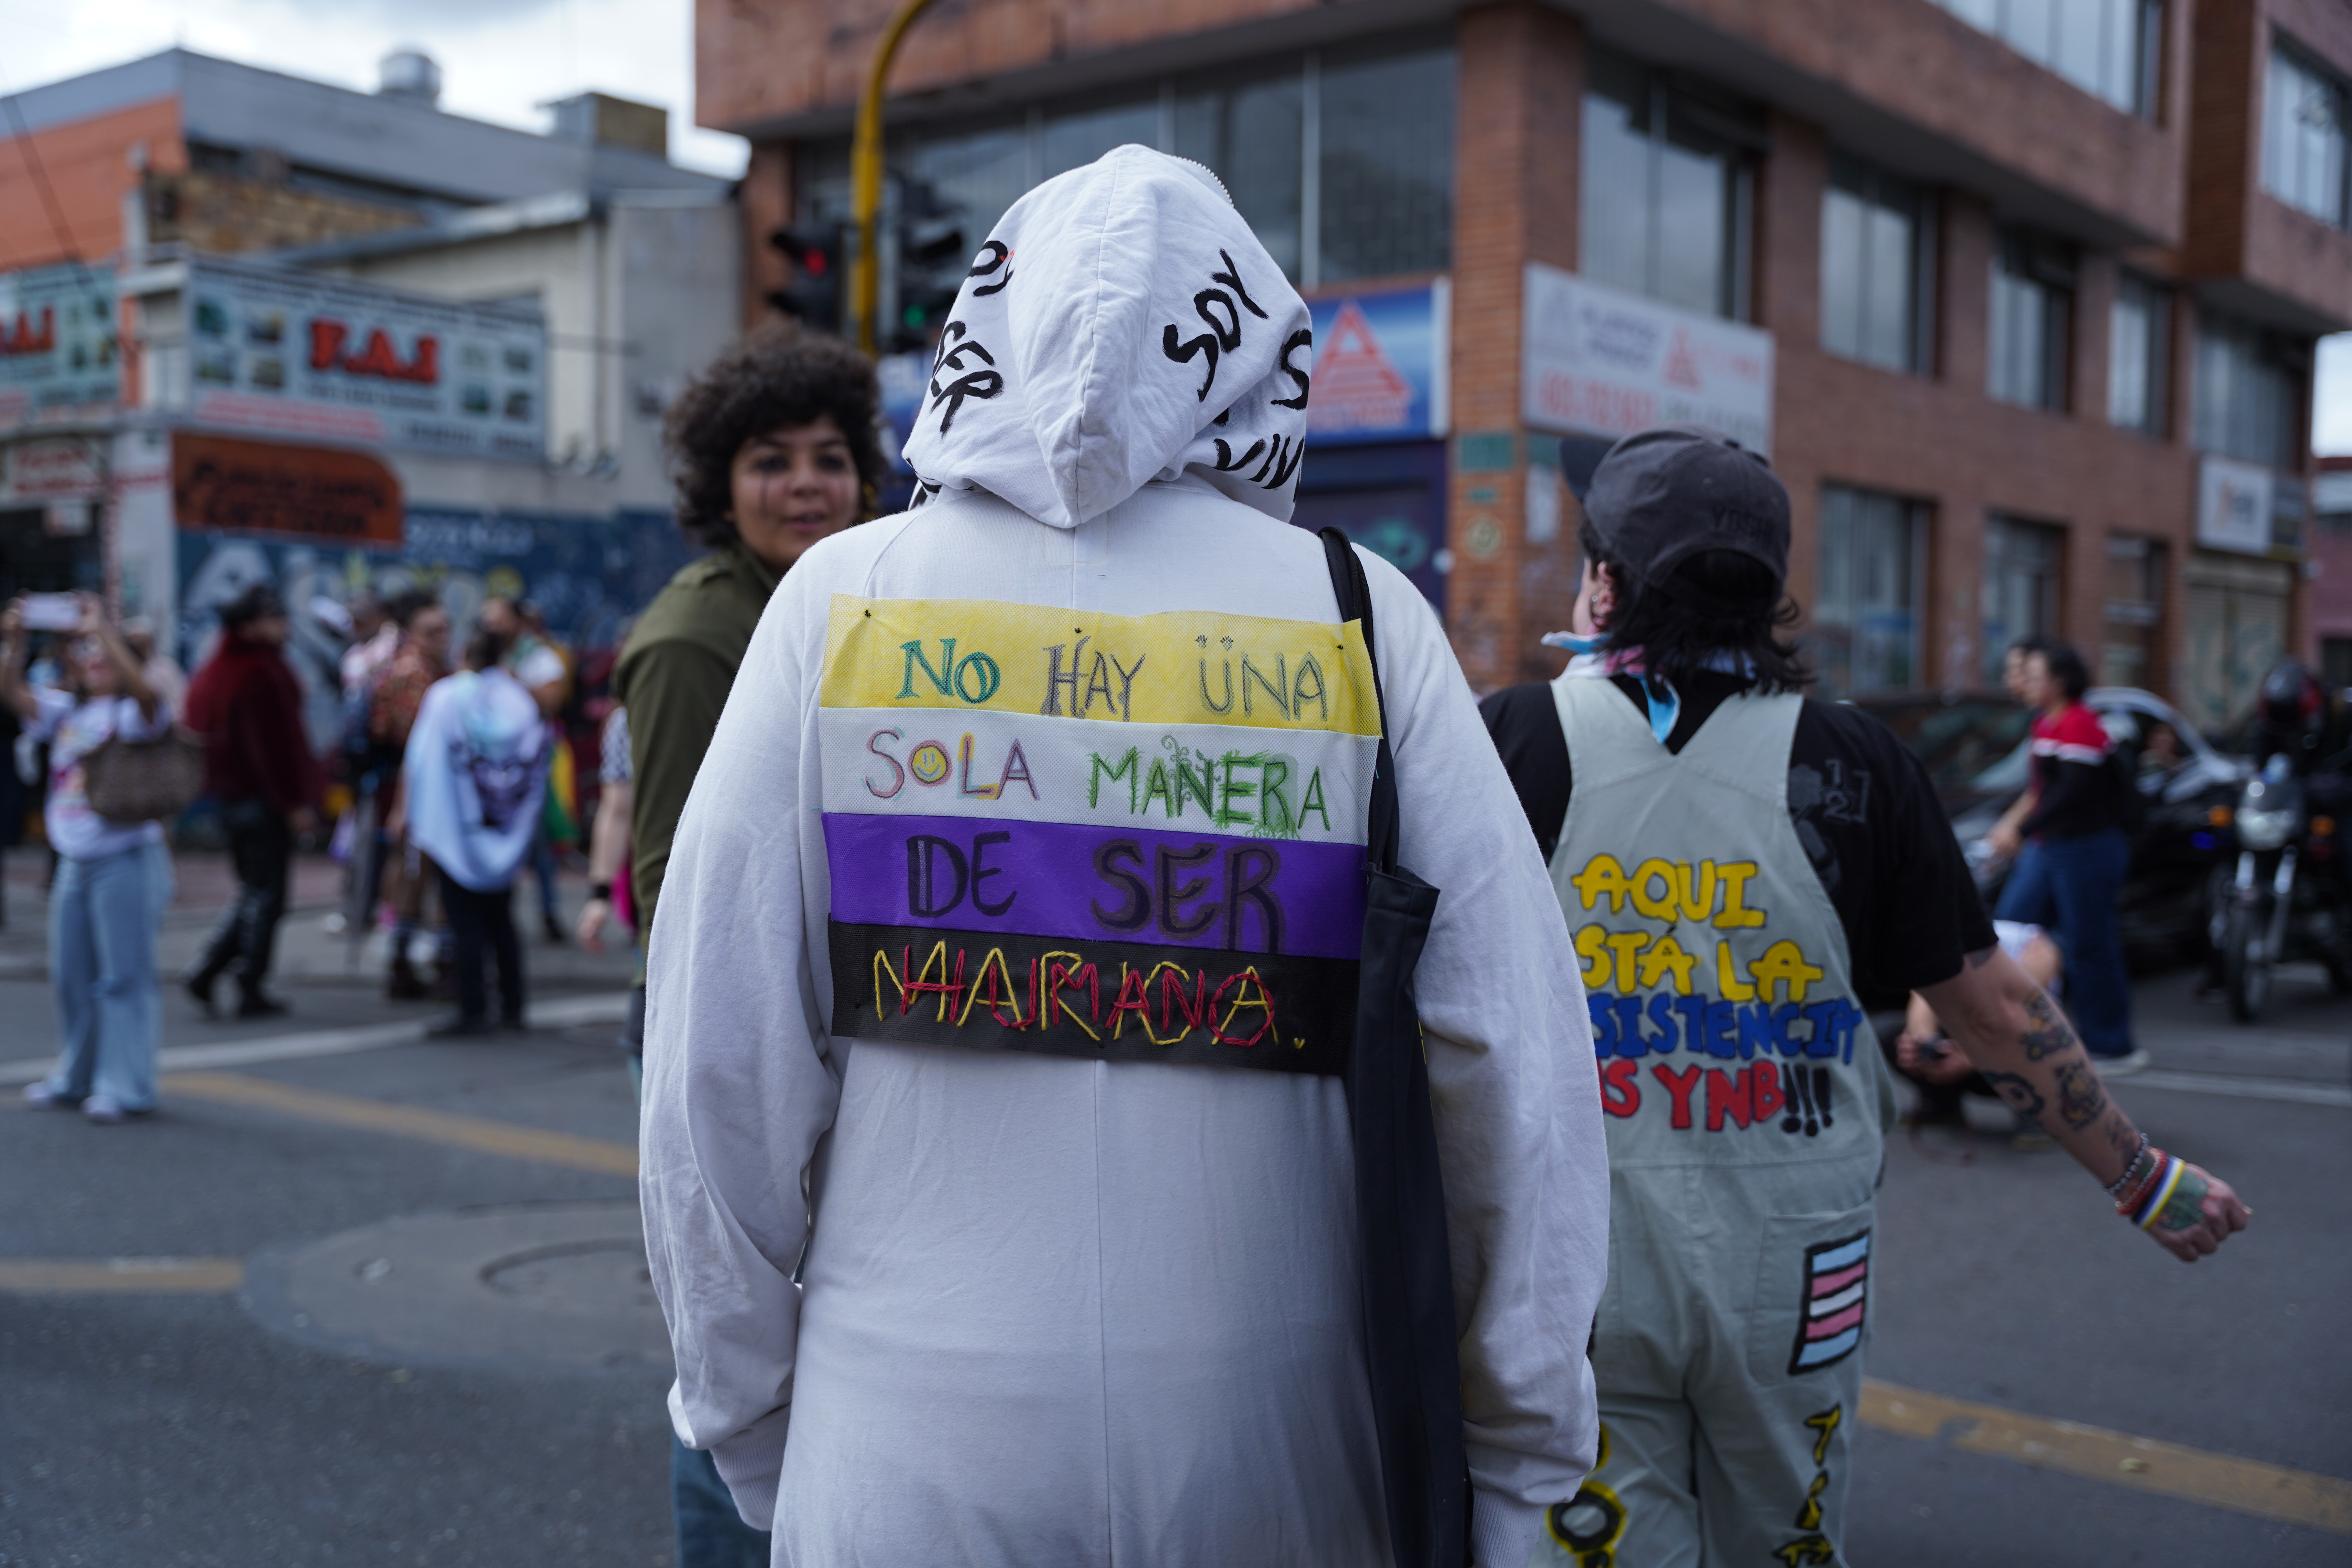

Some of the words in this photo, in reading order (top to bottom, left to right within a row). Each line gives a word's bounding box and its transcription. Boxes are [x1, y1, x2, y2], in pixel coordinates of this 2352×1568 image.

[1163, 248, 1269, 403] SOY
[895, 637, 1000, 704] NO
[1040, 635, 1146, 722] HAY
[865, 727, 1040, 802] SOLA
[1086, 740, 1331, 836] MANERA
[906, 830, 1017, 917] DE
[1089, 837, 1287, 955] SER
[1572, 853, 1767, 929] AQUI
[1716, 939, 1824, 1004] LA
[1596, 1058, 1640, 1118] S
